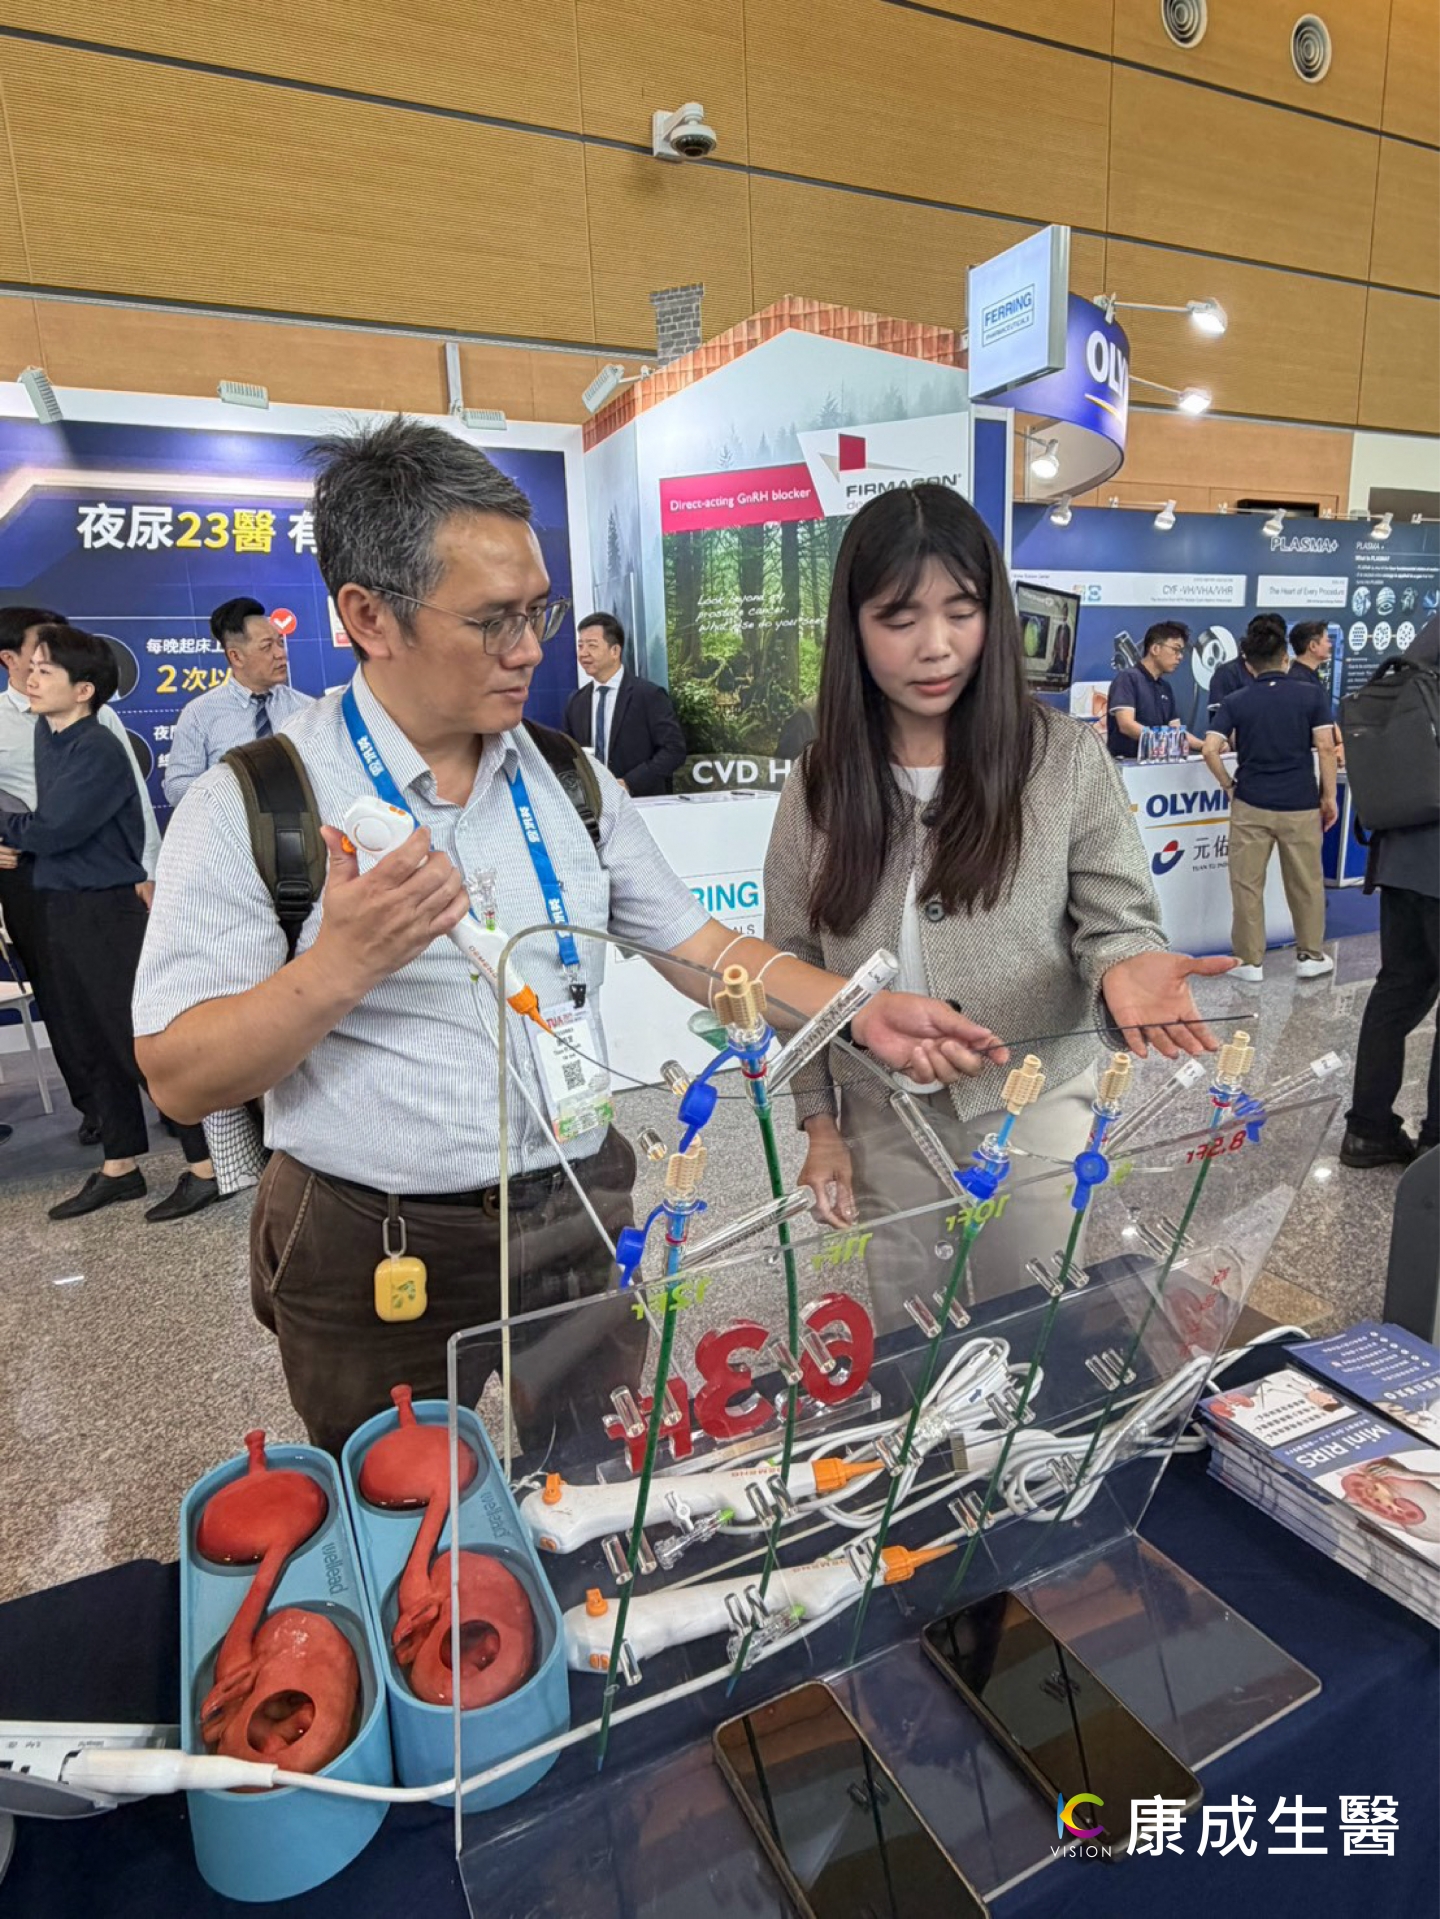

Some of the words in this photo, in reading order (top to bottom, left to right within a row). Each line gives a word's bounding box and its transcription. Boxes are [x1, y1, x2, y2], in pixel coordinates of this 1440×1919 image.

[984, 291, 1033, 327] FERRING
[669, 496, 735, 512] Direct-acting
[737, 489, 769, 505] GnRH
[771, 487, 812, 502] blocker
[76, 502, 276, 553] 夜尿23醫
[697, 594, 724, 606] Look
[153, 725, 176, 741] 夜
[692, 760, 759, 784] CVD
[1345, 1423, 1392, 1451] Mini
[1295, 1440, 1348, 1469] RIRS
[321, 1541, 348, 1596] wellead
